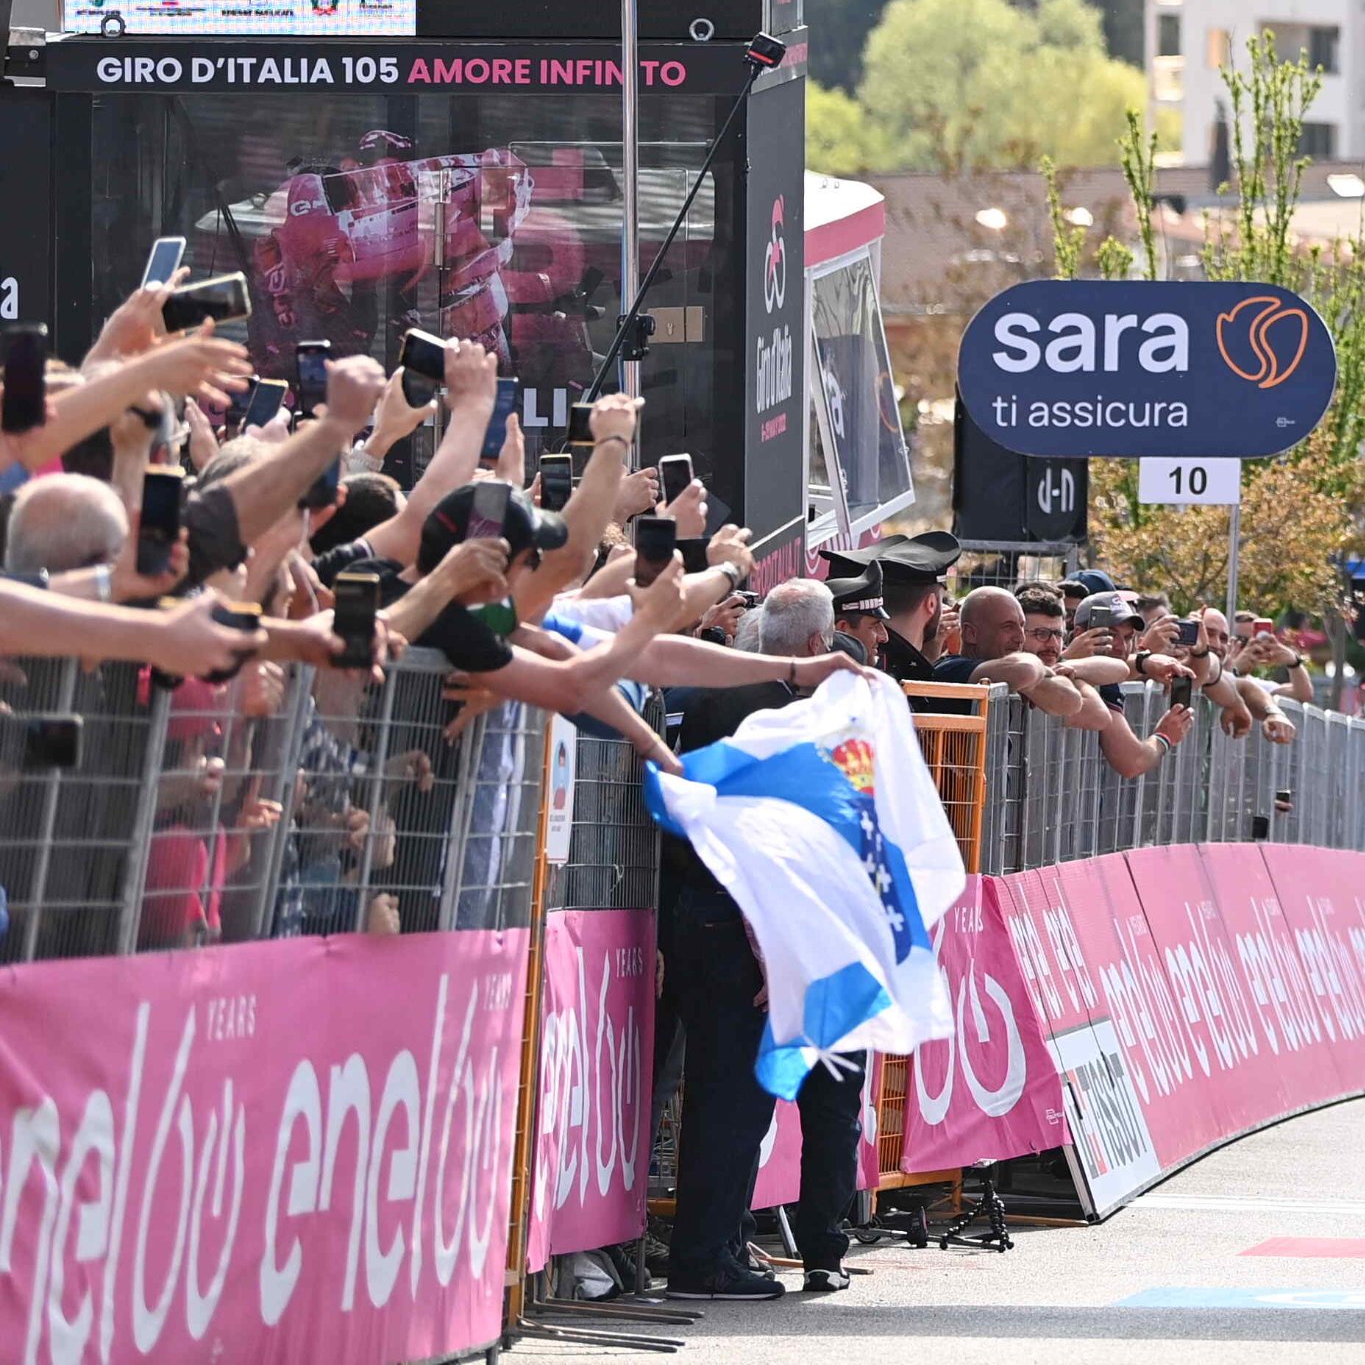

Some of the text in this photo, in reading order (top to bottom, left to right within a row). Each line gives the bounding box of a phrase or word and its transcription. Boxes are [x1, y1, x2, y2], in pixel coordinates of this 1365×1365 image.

[96, 56, 687, 87] GIRO D'ITALIA 105 AMORE INFINTO
[992, 311, 1190, 373] sara
[992, 395, 1189, 428] ti assicura
[1168, 466, 1208, 496] 10
[616, 946, 643, 978] YEARS
[206, 994, 257, 1040] YEARS
[259, 973, 448, 1327] enel
